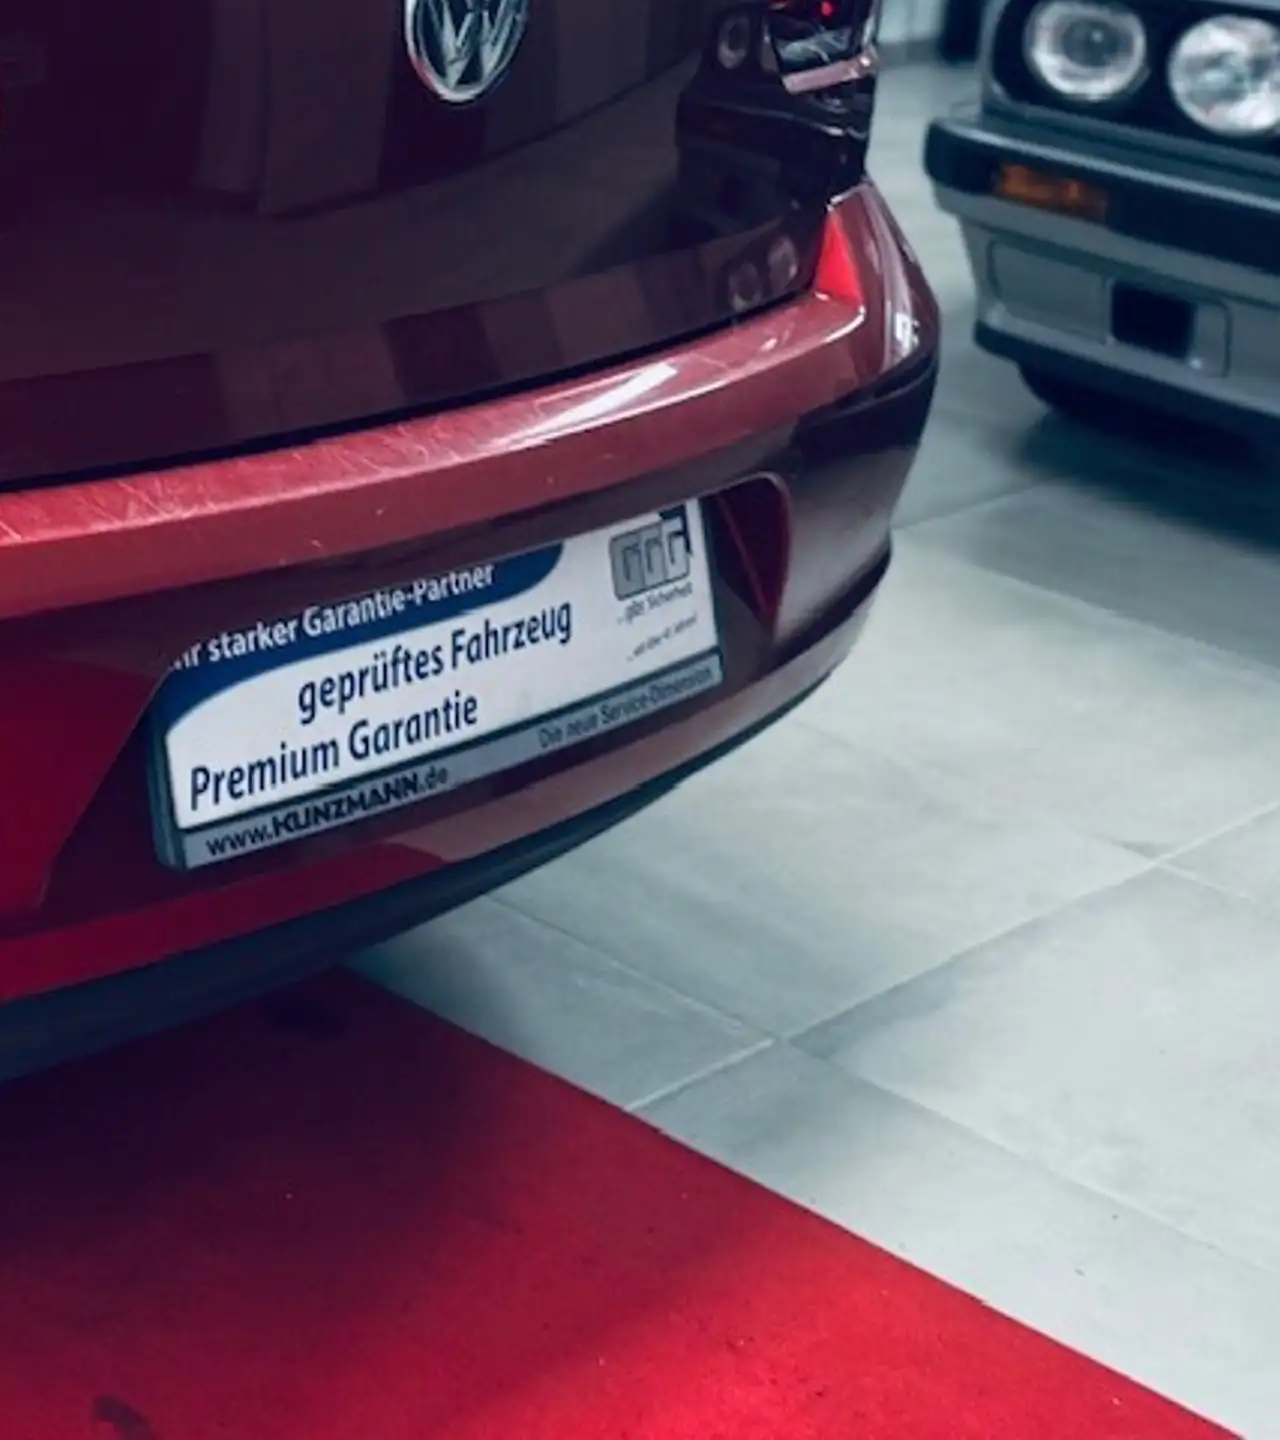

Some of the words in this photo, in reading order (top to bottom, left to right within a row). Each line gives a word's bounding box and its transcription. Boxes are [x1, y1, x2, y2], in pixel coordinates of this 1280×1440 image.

[207, 617, 299, 663] starker
[302, 563, 496, 638] Garantie-Partner
[297, 643, 445, 725] geprüftes
[450, 601, 573, 662] Fahrzeug
[190, 738, 340, 812] Premium
[348, 689, 479, 761] Garantie
[205, 765, 449, 857] www.KUNZMANN.de
